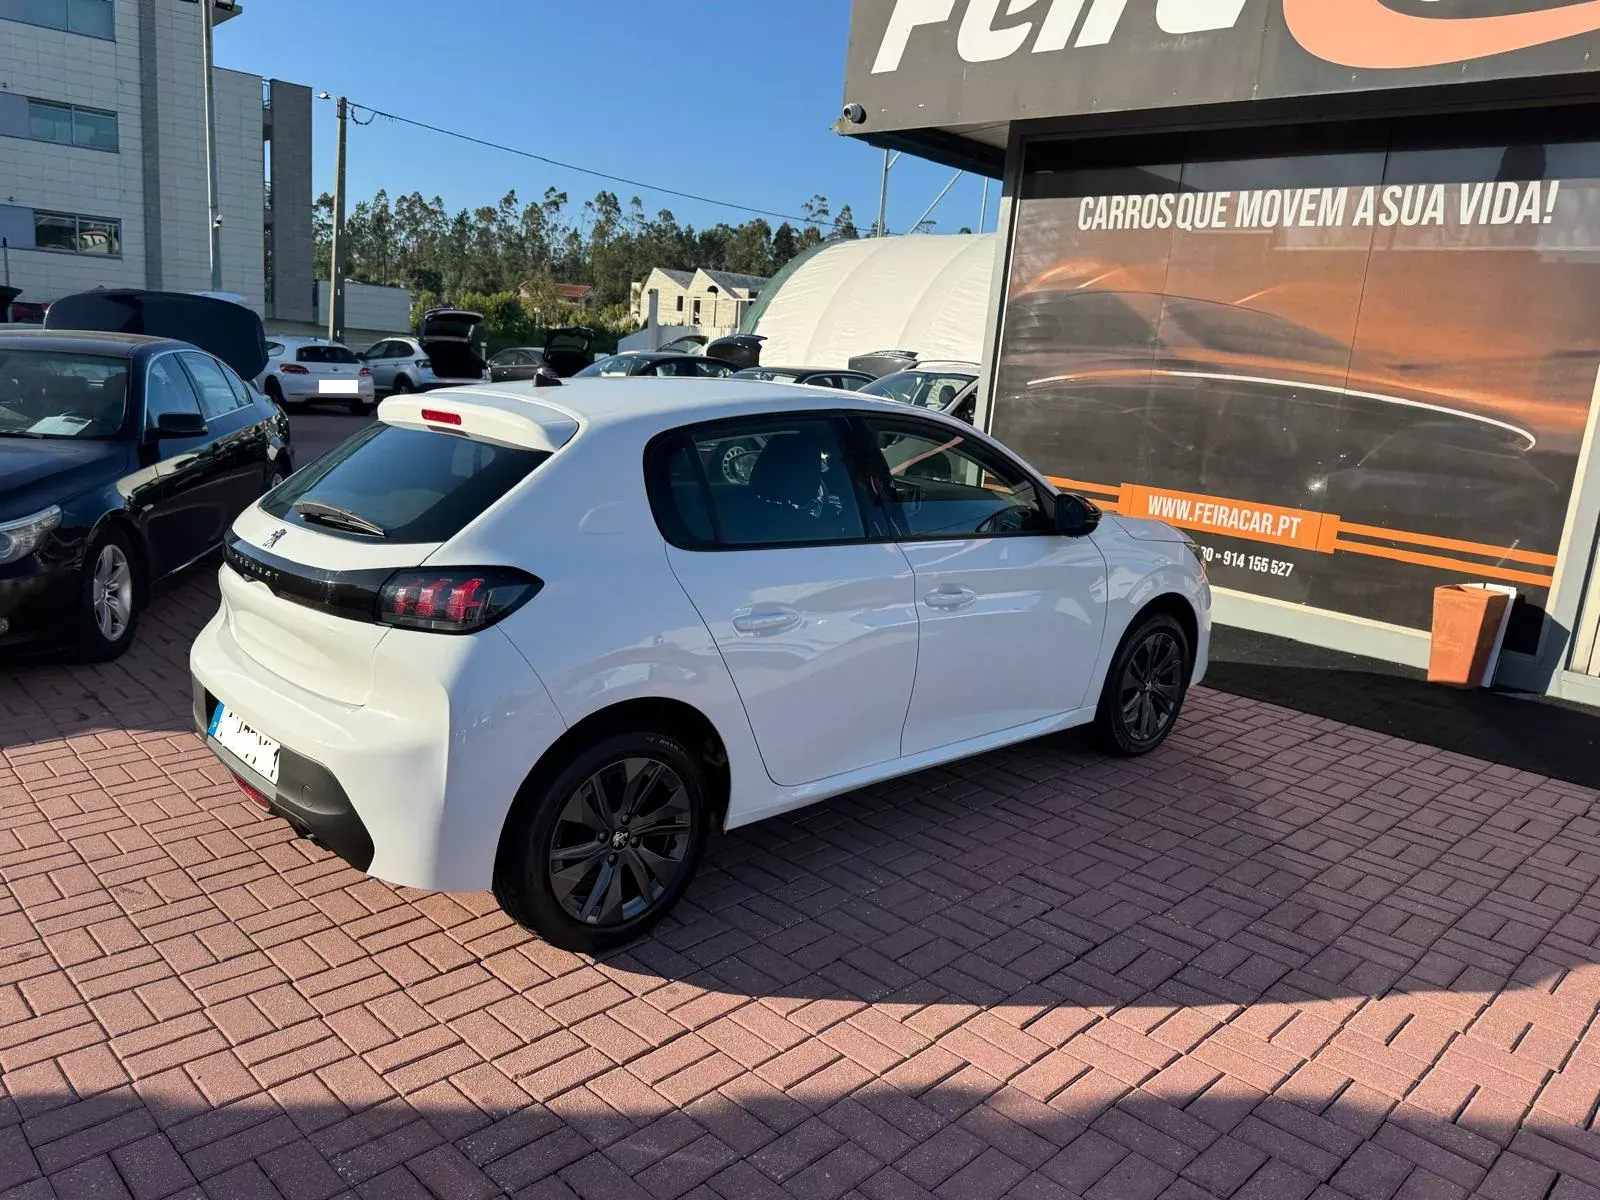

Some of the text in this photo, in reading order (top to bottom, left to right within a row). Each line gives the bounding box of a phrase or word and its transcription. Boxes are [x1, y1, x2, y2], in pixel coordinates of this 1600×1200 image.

[1078, 180, 1560, 231] CARROS QUE MOVEM A SUA VIDA!
[1147, 495, 1302, 539] WWW.FEIRACAR.PT
[1223, 550, 1245, 568] 914
[1248, 555, 1270, 573] 155
[1270, 559, 1294, 578] 527
